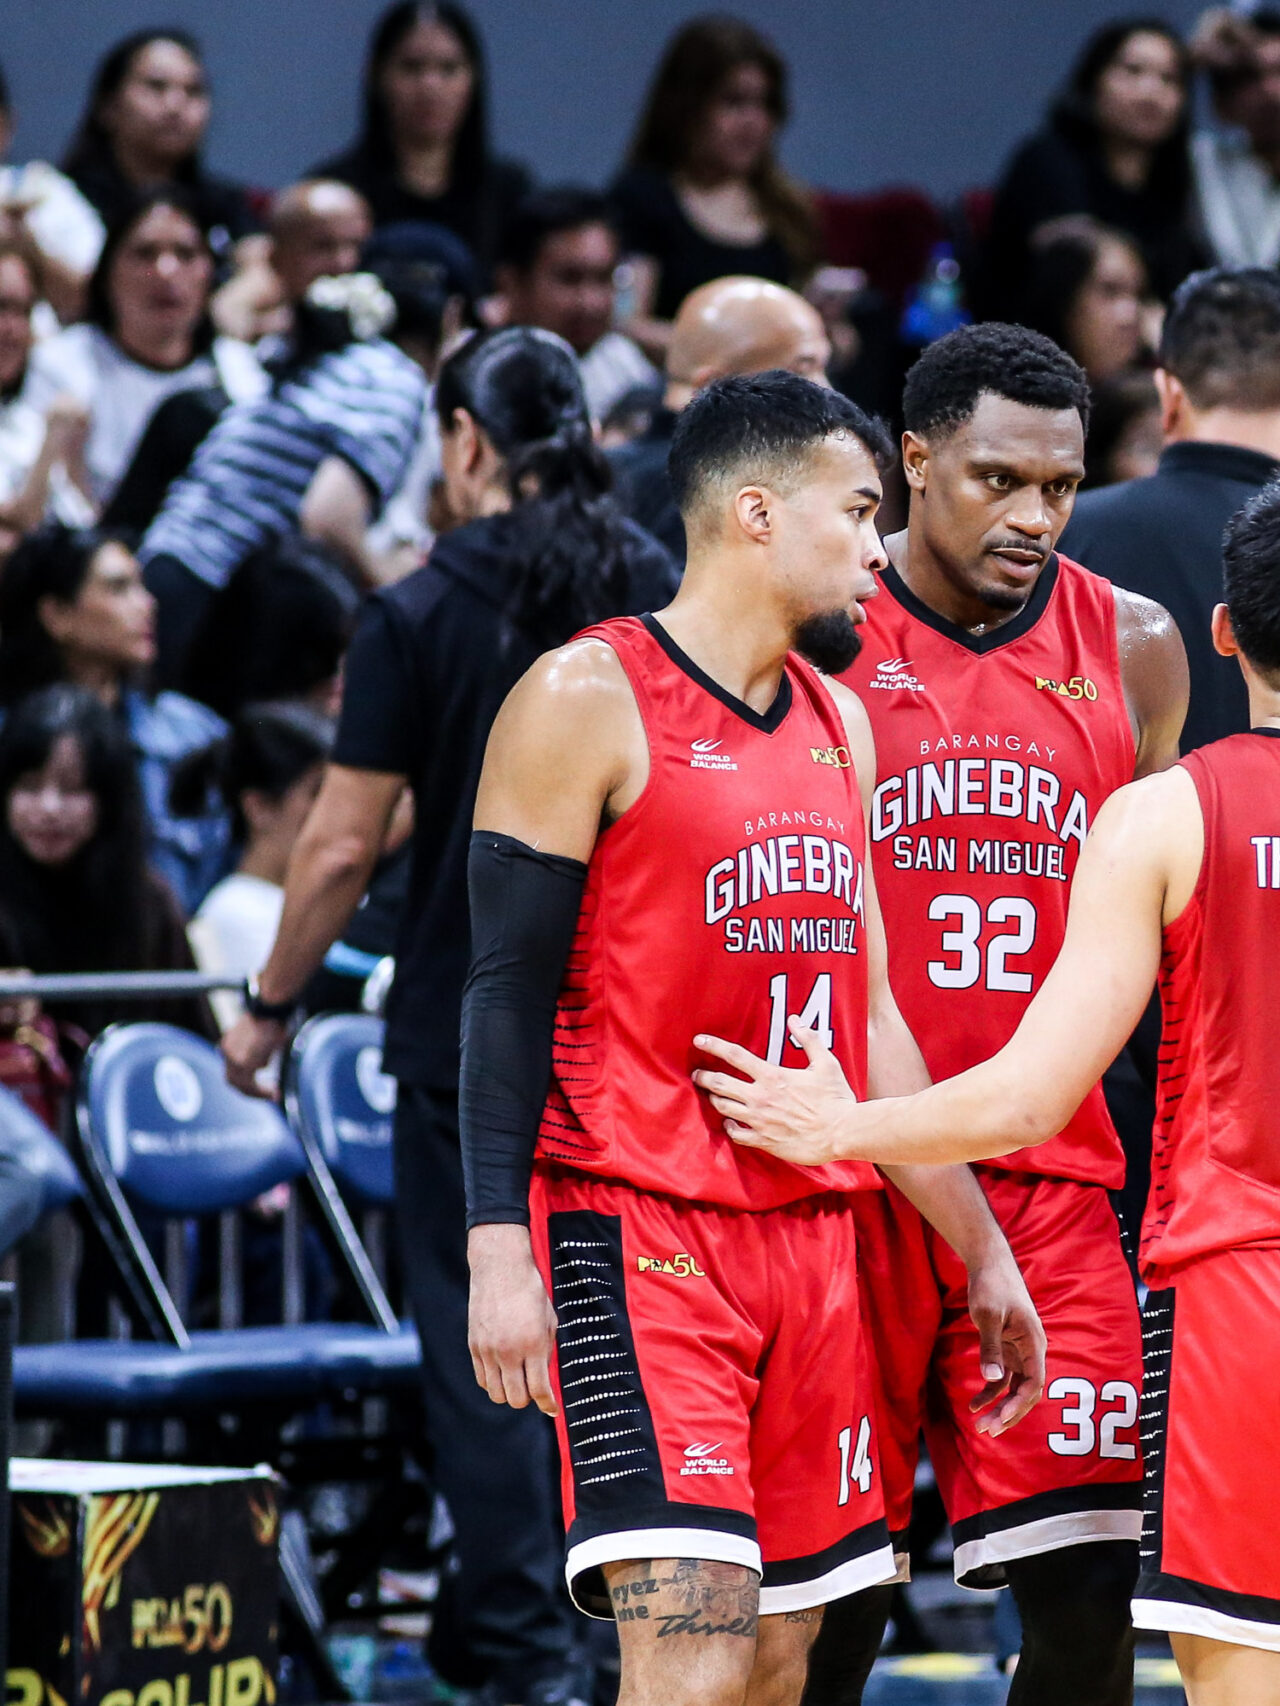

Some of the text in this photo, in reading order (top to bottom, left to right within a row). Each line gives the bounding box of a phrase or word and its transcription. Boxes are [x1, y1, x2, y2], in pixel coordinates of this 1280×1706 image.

[868, 680, 926, 692] BALANCE
[877, 672, 918, 684] WORLD
[692, 752, 731, 762] WORLD
[920, 734, 1056, 762] BARANGAY
[690, 760, 738, 771] BALANCE
[871, 758, 1089, 854] GINEBRA
[745, 811, 845, 836] BARANGAY
[894, 834, 1068, 881] SAN MIGUEL
[705, 835, 866, 928] GINEBRA
[725, 917, 858, 955] SAN MIGUEL
[927, 894, 1038, 993] 32
[766, 972, 833, 1067] 14
[1047, 1376, 1138, 1460] 32
[680, 1466, 734, 1476] BALANCE
[685, 1458, 728, 1467] WORLD
[837, 1416, 874, 1507] 14
